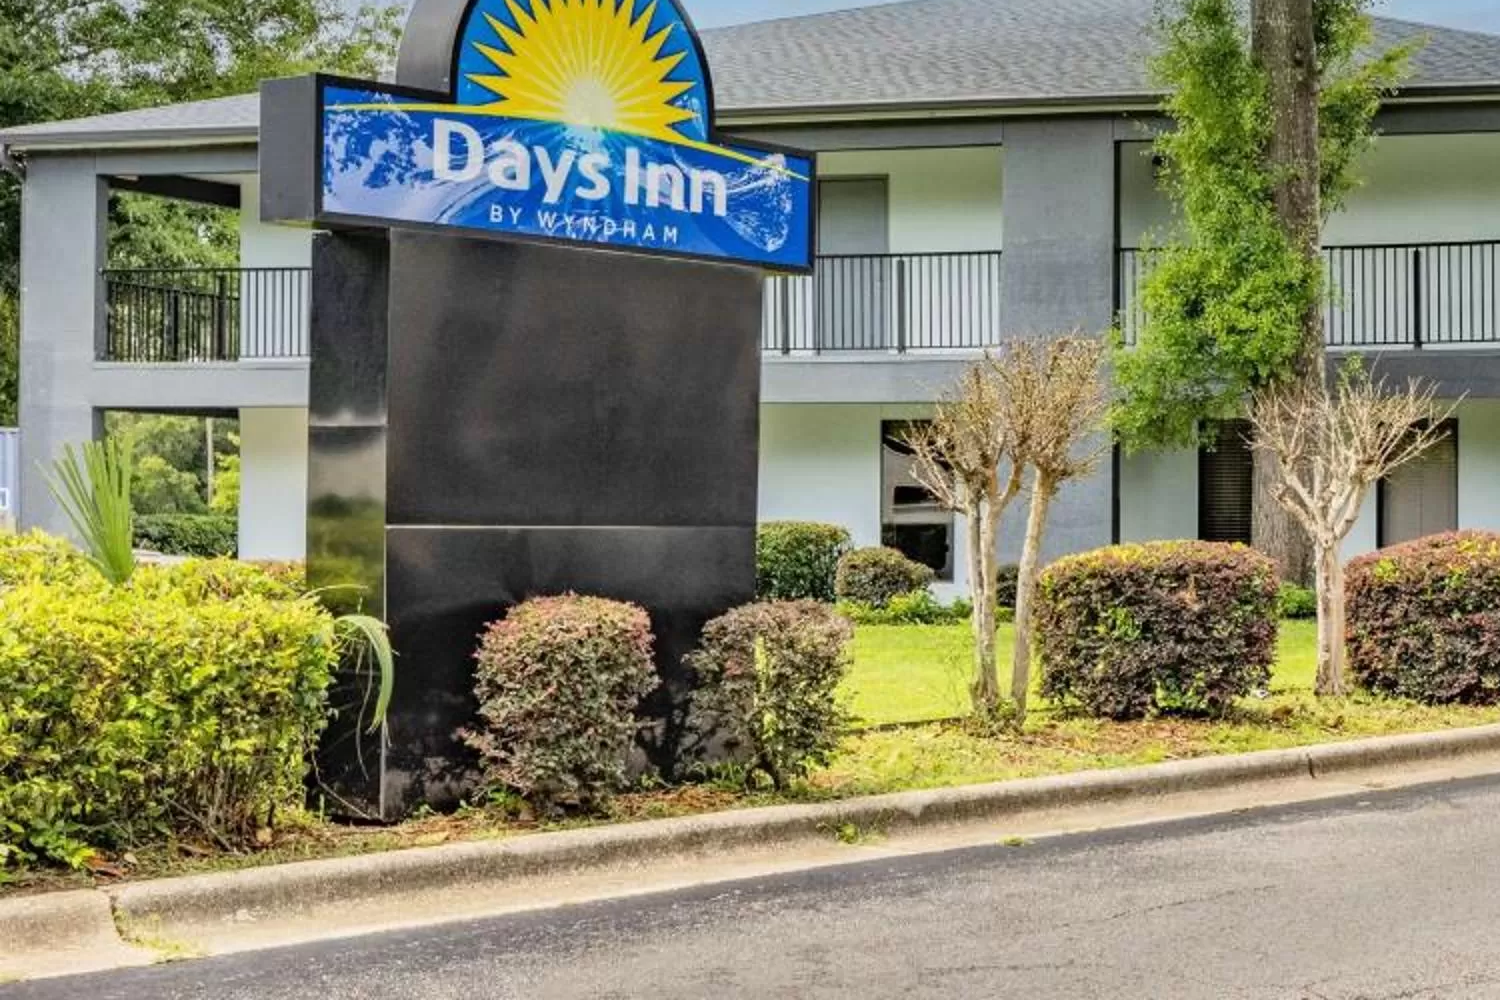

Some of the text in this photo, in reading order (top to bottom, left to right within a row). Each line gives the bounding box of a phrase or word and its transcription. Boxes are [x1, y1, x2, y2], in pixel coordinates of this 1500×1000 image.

[433, 118, 727, 217] Days Inn
[489, 203, 678, 245] BY WYNDHAM
